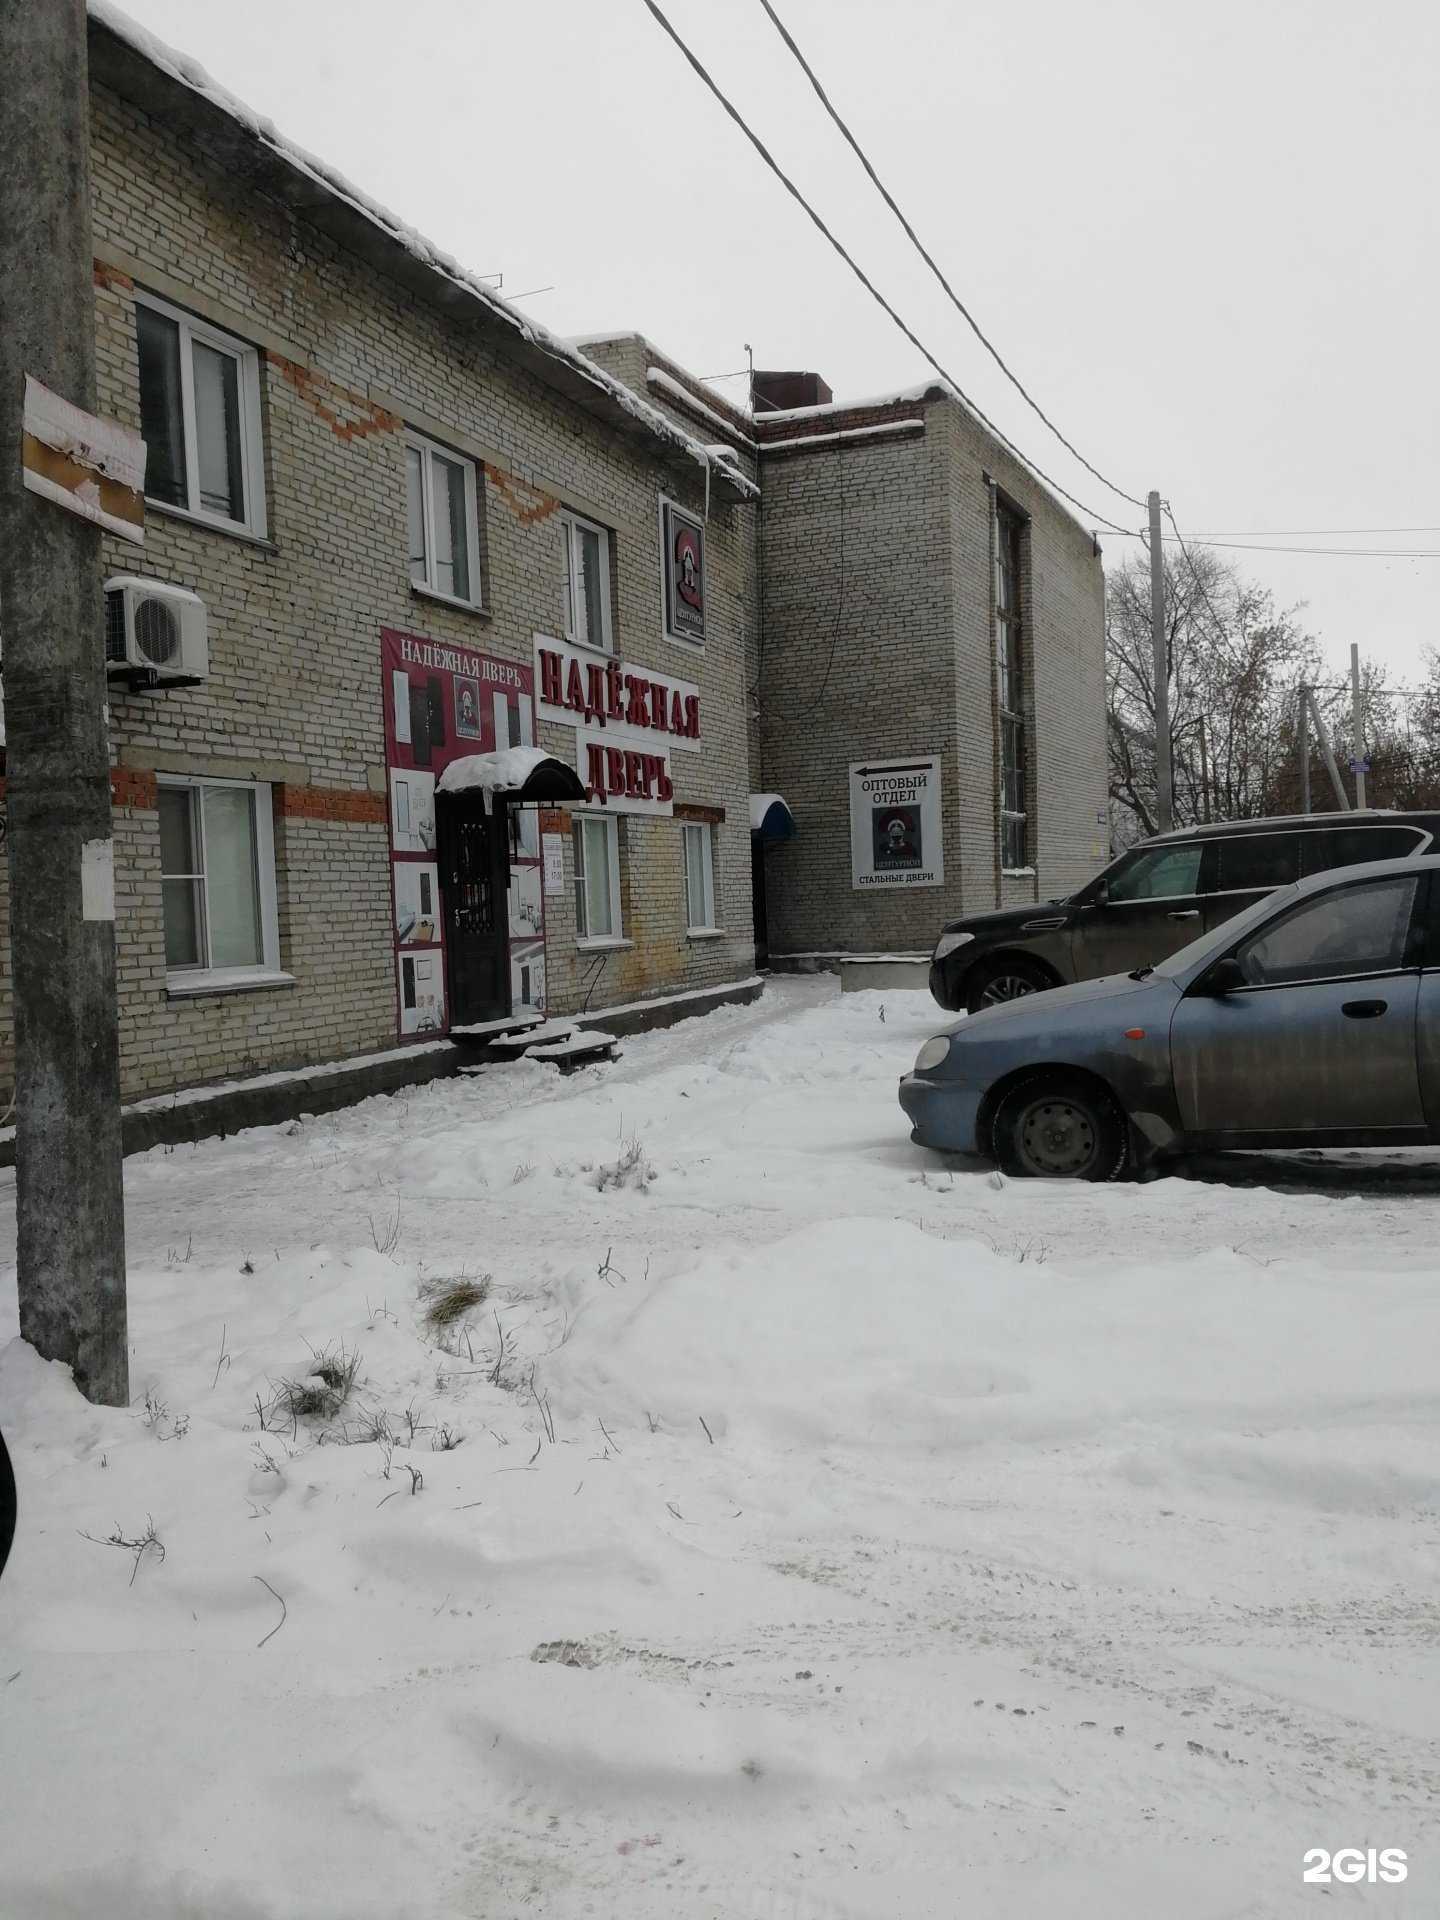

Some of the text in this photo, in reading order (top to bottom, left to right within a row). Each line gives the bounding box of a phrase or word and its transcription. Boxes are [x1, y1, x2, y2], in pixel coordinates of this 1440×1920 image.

[400, 639, 522, 688] НАДЁЖНАЯ ДВЕРЬ
[538, 649, 700, 739] НАДЁЖНАЯ
[585, 743, 673, 805] ДВЕРЬ
[861, 773, 927, 792] ОПТОВЫЙ
[872, 789, 916, 805] ОТДЕЛ
[859, 872, 934, 884] СТАЛЬНЫЕ ДВЕРИ
